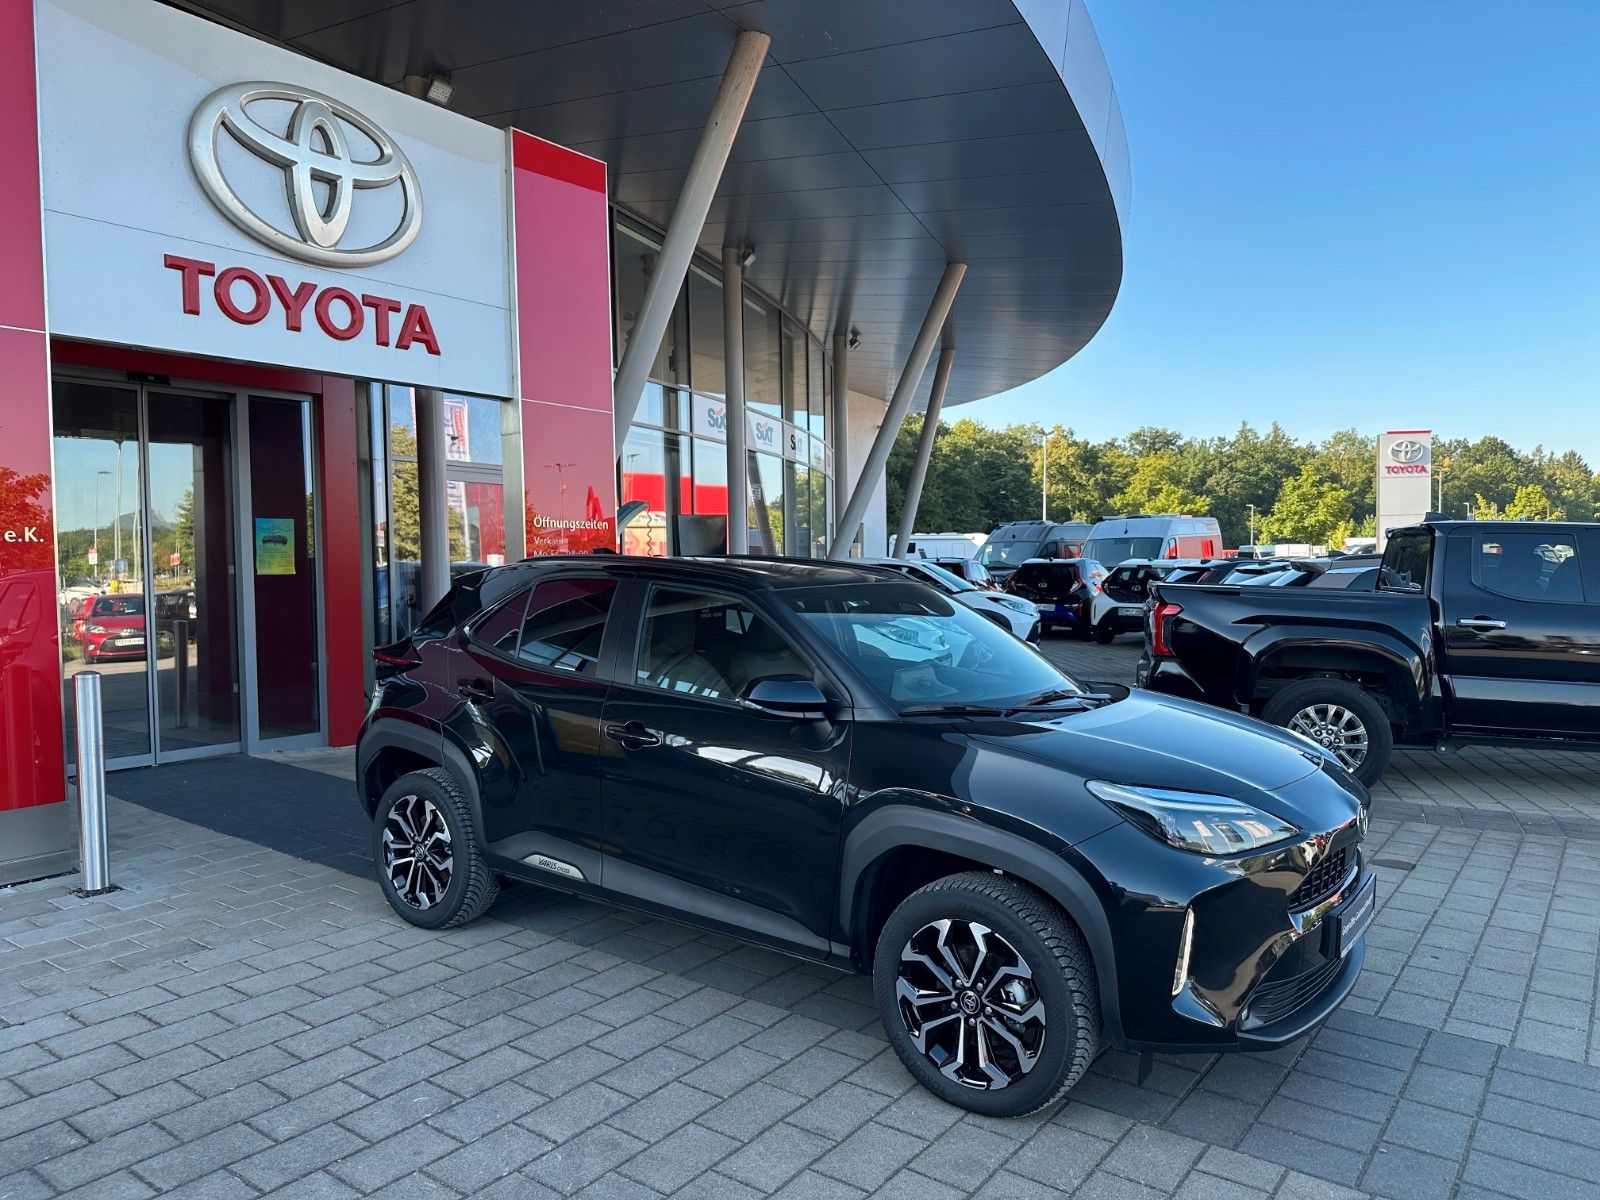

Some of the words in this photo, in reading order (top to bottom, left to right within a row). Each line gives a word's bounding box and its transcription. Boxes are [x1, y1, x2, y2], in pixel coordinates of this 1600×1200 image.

[164, 254, 441, 355] TOYOTA
[1385, 465, 1427, 474] TOYOTA
[533, 514, 609, 532] Öffnungszeiten
[4, 526, 45, 543] e.K.
[538, 858, 557, 870] YARIS
